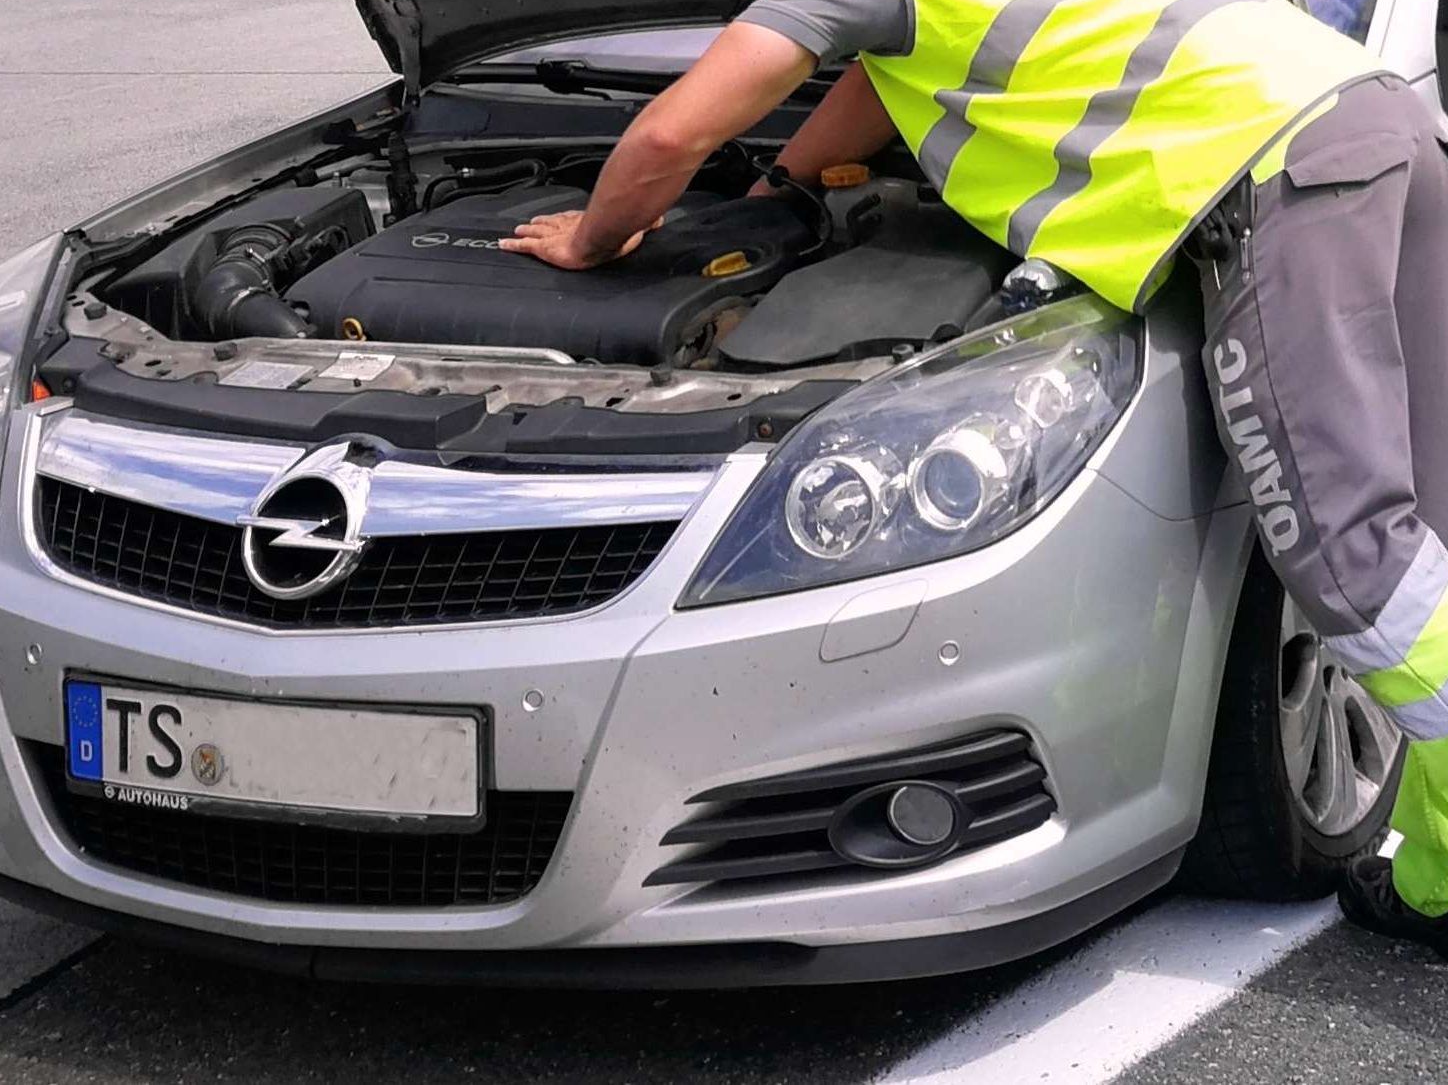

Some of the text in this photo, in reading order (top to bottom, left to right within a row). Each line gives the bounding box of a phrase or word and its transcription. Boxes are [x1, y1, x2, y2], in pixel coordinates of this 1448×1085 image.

[1213, 338, 1300, 557] ÖAMTC
[80, 740, 93, 762] D
[106, 698, 183, 779] TS
[117, 787, 189, 811] AUTOHAUS
